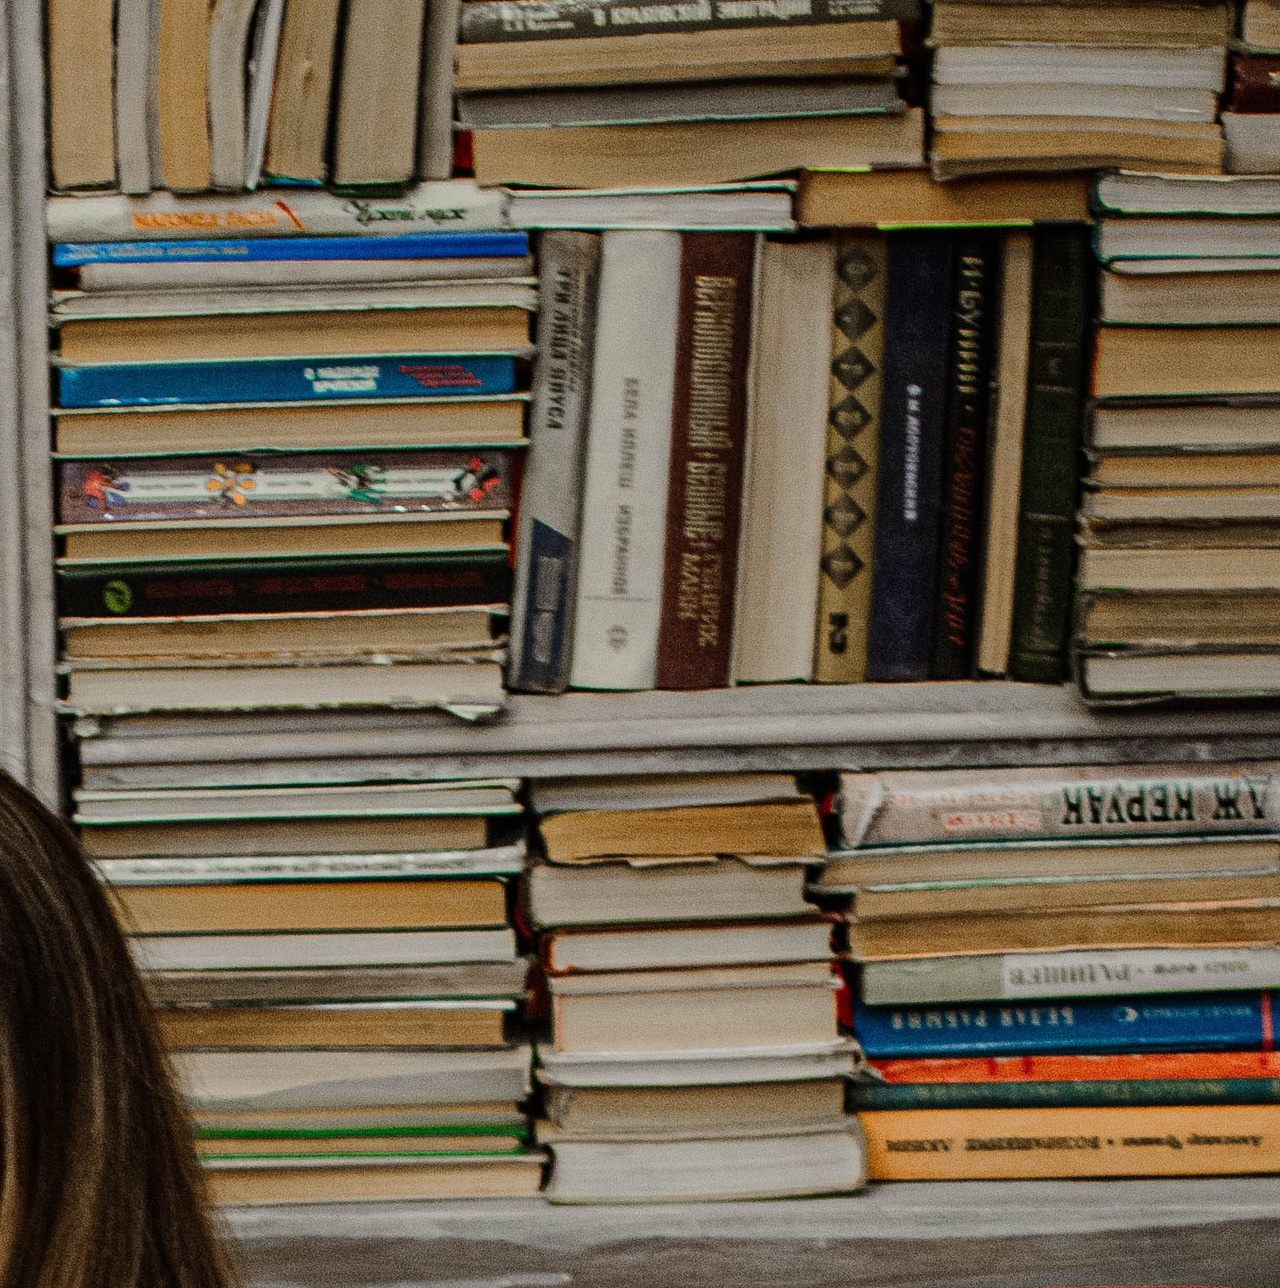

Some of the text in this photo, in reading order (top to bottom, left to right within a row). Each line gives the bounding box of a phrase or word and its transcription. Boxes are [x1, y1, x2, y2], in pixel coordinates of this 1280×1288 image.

[549, 309, 571, 361] ЛИЦА
[622, 377, 640, 421] БЕЛА
[611, 504, 633, 596] ИЗБРАННОЕ
[1061, 782, 1196, 826] КЕРУАК
